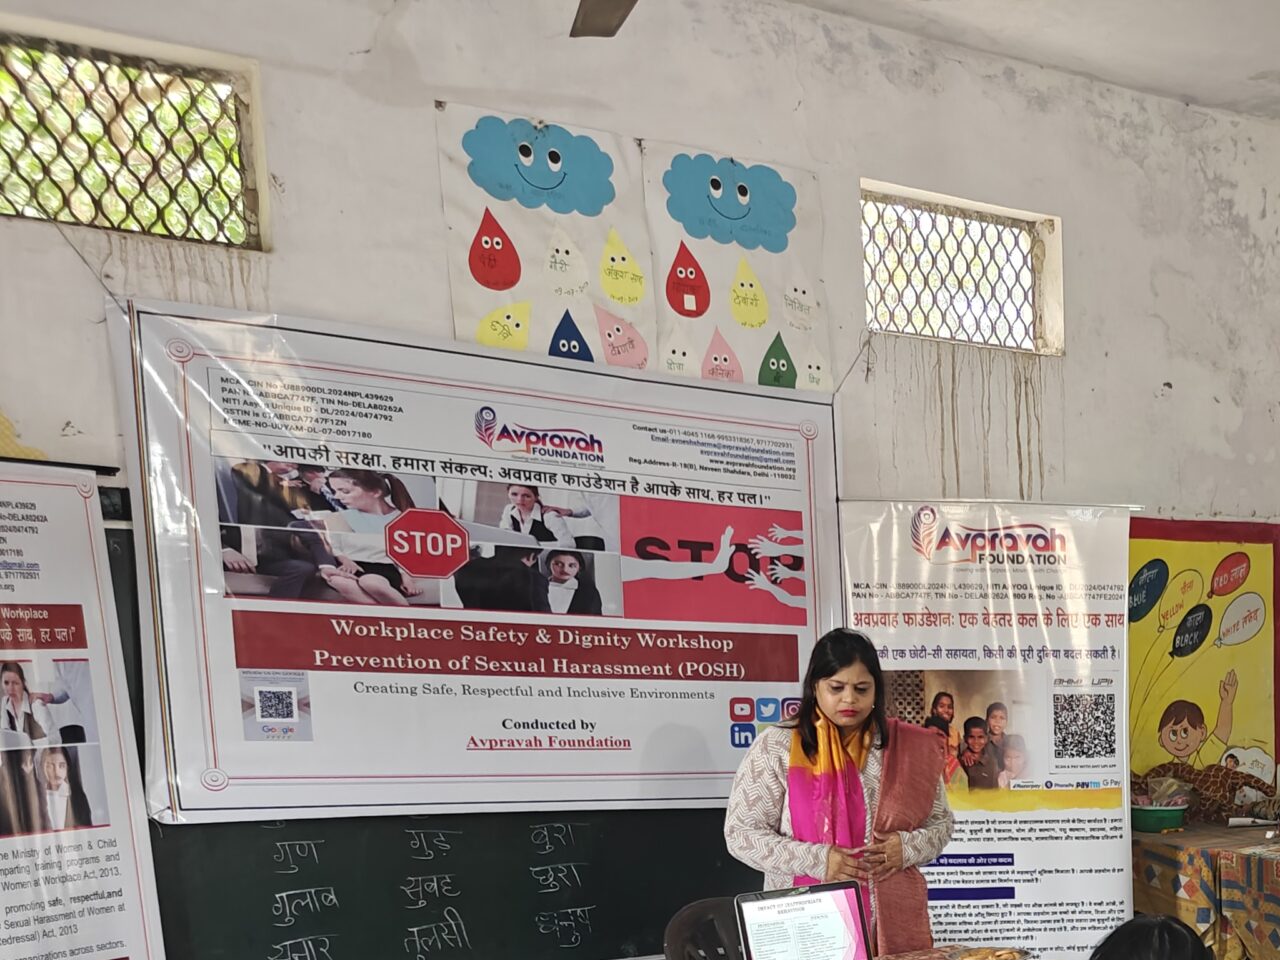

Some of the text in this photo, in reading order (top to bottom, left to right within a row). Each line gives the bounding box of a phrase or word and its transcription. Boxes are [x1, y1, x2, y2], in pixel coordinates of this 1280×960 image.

[496, 423, 603, 455] Avpravah
[532, 446, 605, 464] FOUNDATION
[392, 455, 435, 474] हमारा
[498, 465, 557, 487] अवप्रवाह
[562, 470, 626, 493] फाउंडेशन
[630, 476, 640, 494] है
[643, 481, 682, 500] आपके
[717, 489, 733, 504] हर
[392, 529, 462, 557] STOP
[936, 529, 1067, 559] Avpravah
[978, 553, 1068, 566] FOUNDATION
[1, 607, 48, 621] Workplace
[959, 611, 978, 628] एक
[1018, 611, 1038, 628] कल
[331, 618, 734, 653] Workplace Safety & Dignity Workshop
[1175, 631, 1200, 648] BLACK
[892, 648, 906, 661] एक
[313, 649, 746, 680] Prevention of Sexual Harassment (POSH)
[353, 681, 715, 701] Creating Safe, Respectful and Inclusive Environments
[501, 718, 597, 733] Conducted by
[466, 735, 632, 750] Avpravah Foundation
[274, 822, 591, 874] गुण गुड़ बुरा
[5, 900, 46, 916] promoting
[272, 886, 340, 927] गुलाब
[400, 873, 461, 909] सुबह
[4, 917, 31, 930] Sexual
[69, 944, 94, 956] across
